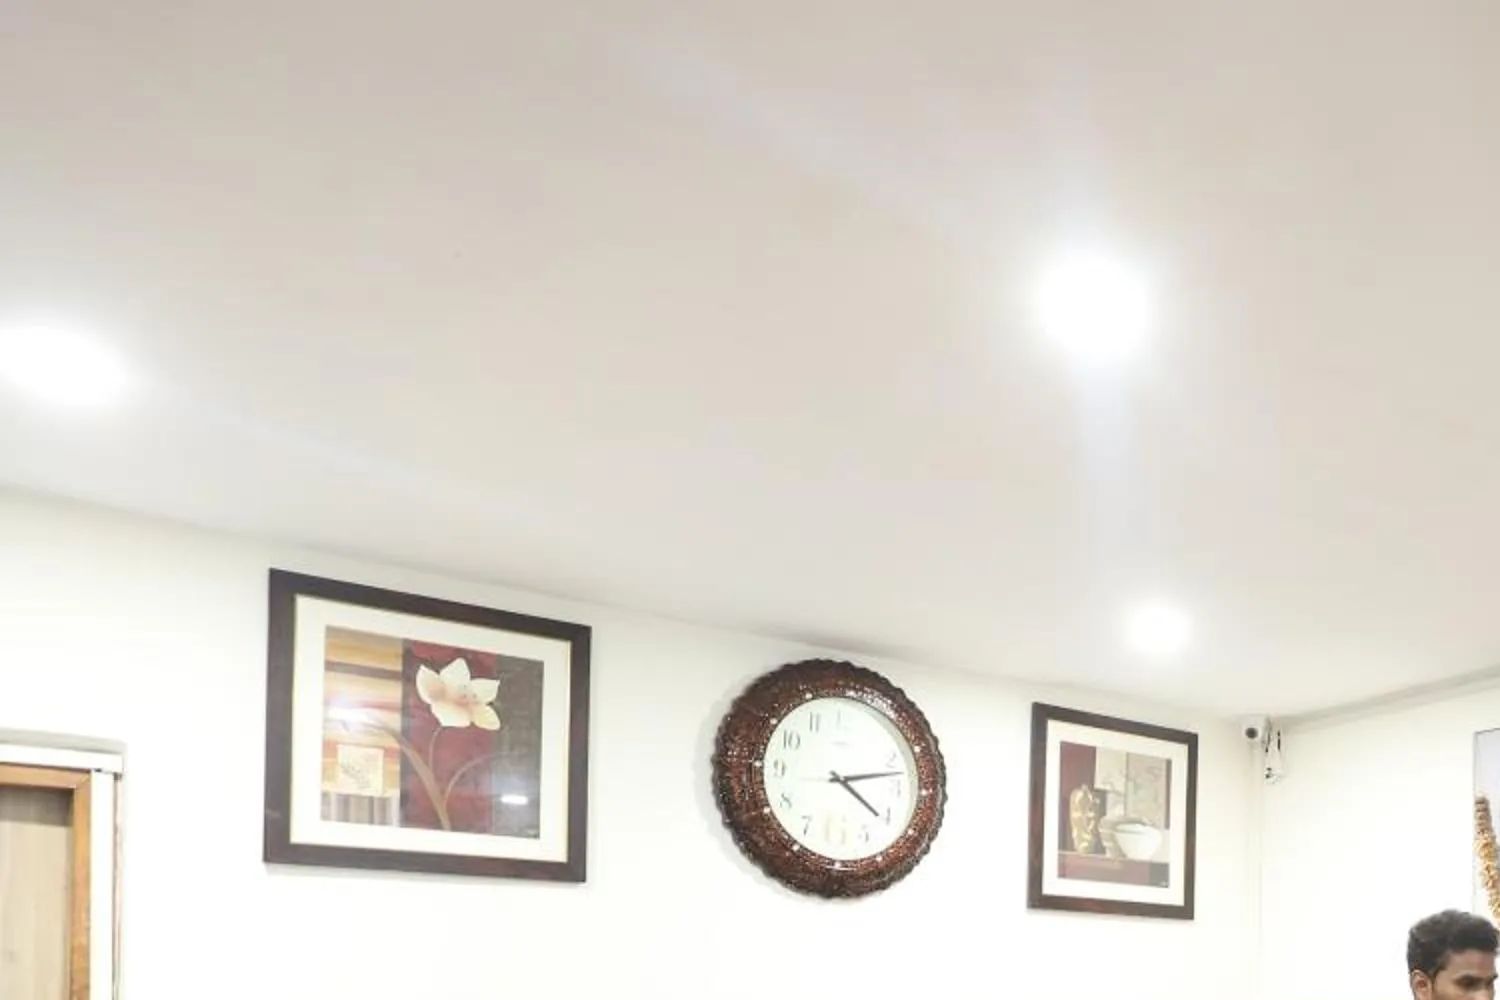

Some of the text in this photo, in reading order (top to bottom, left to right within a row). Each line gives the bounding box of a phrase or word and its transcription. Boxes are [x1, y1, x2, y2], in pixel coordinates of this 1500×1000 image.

[782, 727, 801, 750] 10
[772, 757, 788, 777] 9
[800, 813, 813, 835] 7
